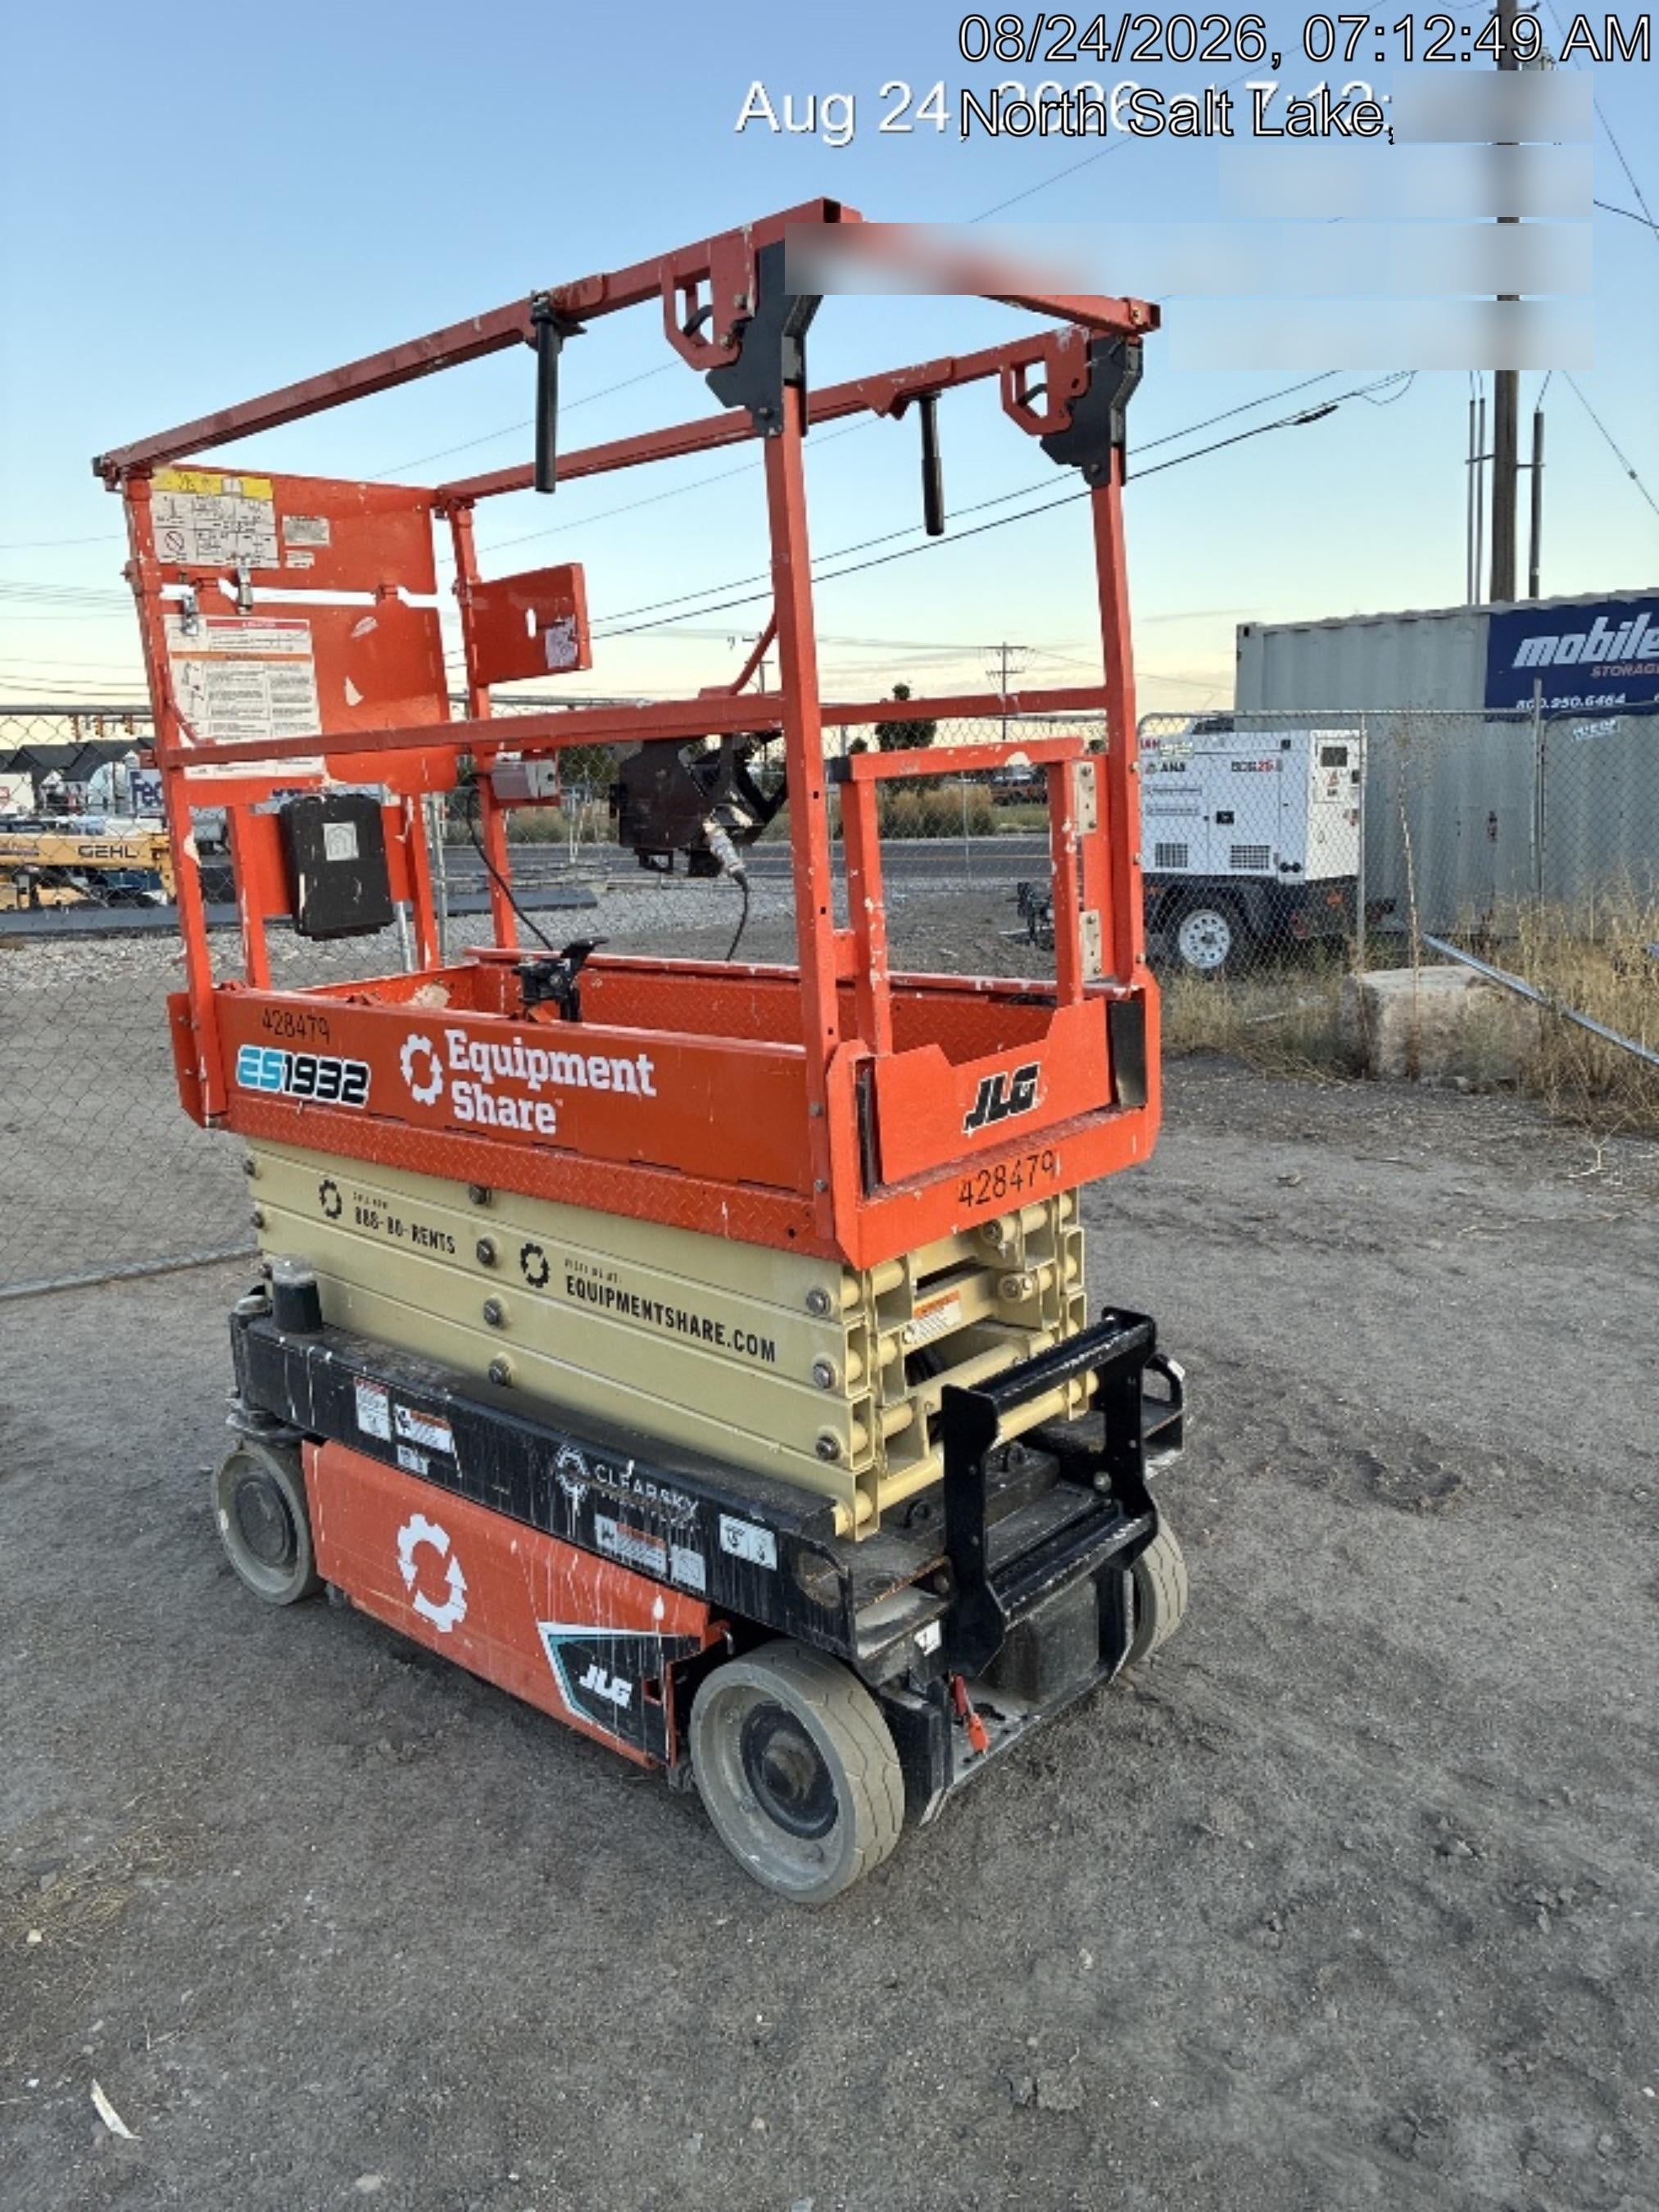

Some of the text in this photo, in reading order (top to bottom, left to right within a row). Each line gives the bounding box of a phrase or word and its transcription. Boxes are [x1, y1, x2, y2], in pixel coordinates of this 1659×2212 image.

[1512, 612, 1659, 668] mobile
[78, 845, 138, 859] GEHL
[262, 1008, 330, 1044] 428479
[445, 1029, 656, 1096] Equipment
[451, 1080, 557, 1135] Share
[963, 1063, 1041, 1136] JLG
[959, 1150, 1055, 1207] 428479
[565, 1275, 776, 1363] EQUIPMENTSHARE.COM
[578, 1663, 632, 1709] JLG
